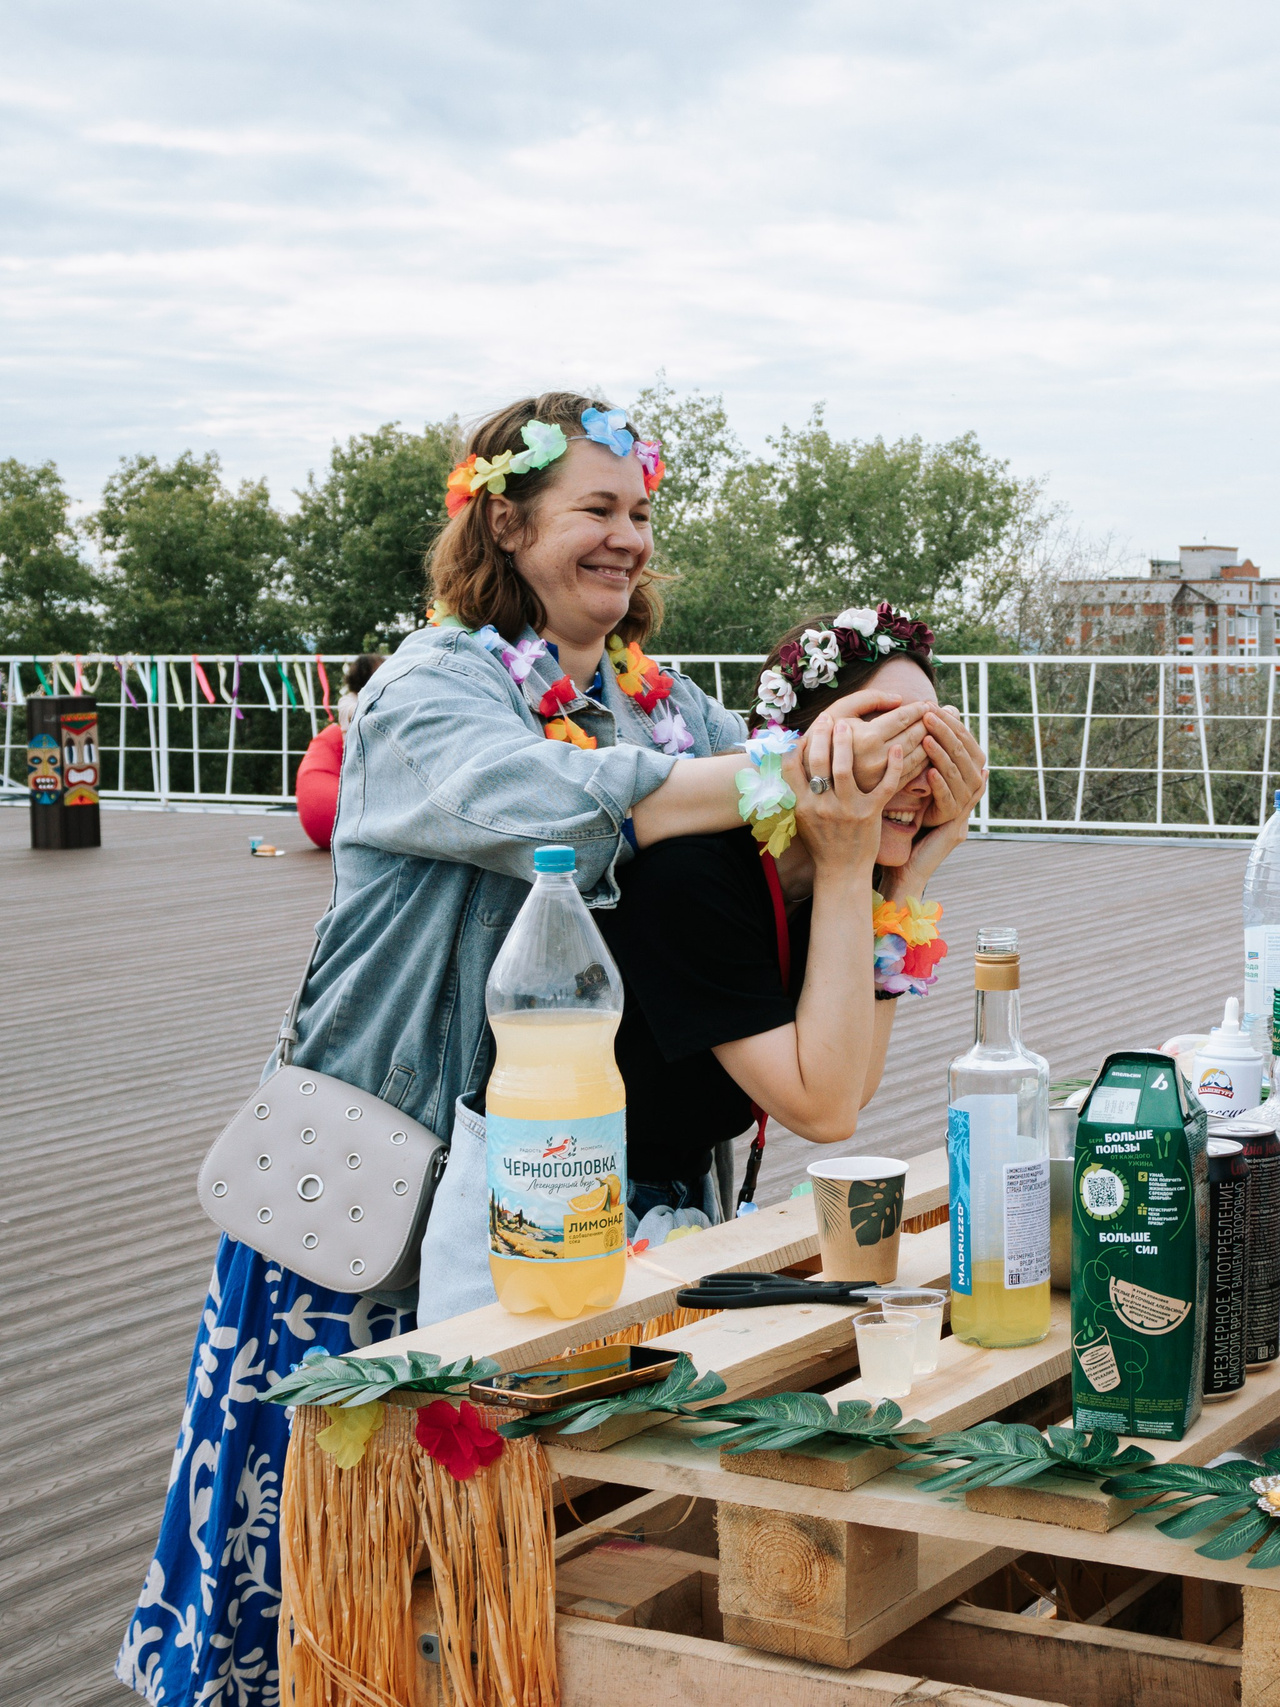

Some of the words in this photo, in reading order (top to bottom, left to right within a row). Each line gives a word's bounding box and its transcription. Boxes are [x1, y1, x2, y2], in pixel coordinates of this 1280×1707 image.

[1104, 1129, 1154, 1143] БОЛЬШЕ
[1095, 1142, 1141, 1155] ПОЛЬЗЫ
[503, 1155, 618, 1179] ЧЕРНОГОЛОВКА
[526, 1178, 579, 1195] Легендарный
[579, 1175, 596, 1193] вкус
[1006, 1186, 1022, 1194] СТРАНА
[1233, 1178, 1247, 1241] ЗДОРОВЬЮ.
[568, 1212, 624, 1234] ЛИМОНАД
[1099, 1232, 1151, 1243] БОЛЬШЕ
[1216, 1181, 1234, 1293] УПОТРЕБЛЕНИЕ
[1135, 1245, 1158, 1255] СИЛ
[1231, 1242, 1244, 1289] ВАШЕМУ
[1230, 1291, 1243, 1330] ВРЕДИТ
[1213, 1296, 1231, 1389] ЧРЕЗМЕРНОЕ
[1229, 1333, 1240, 1385] АЛКОГОЛЯ
